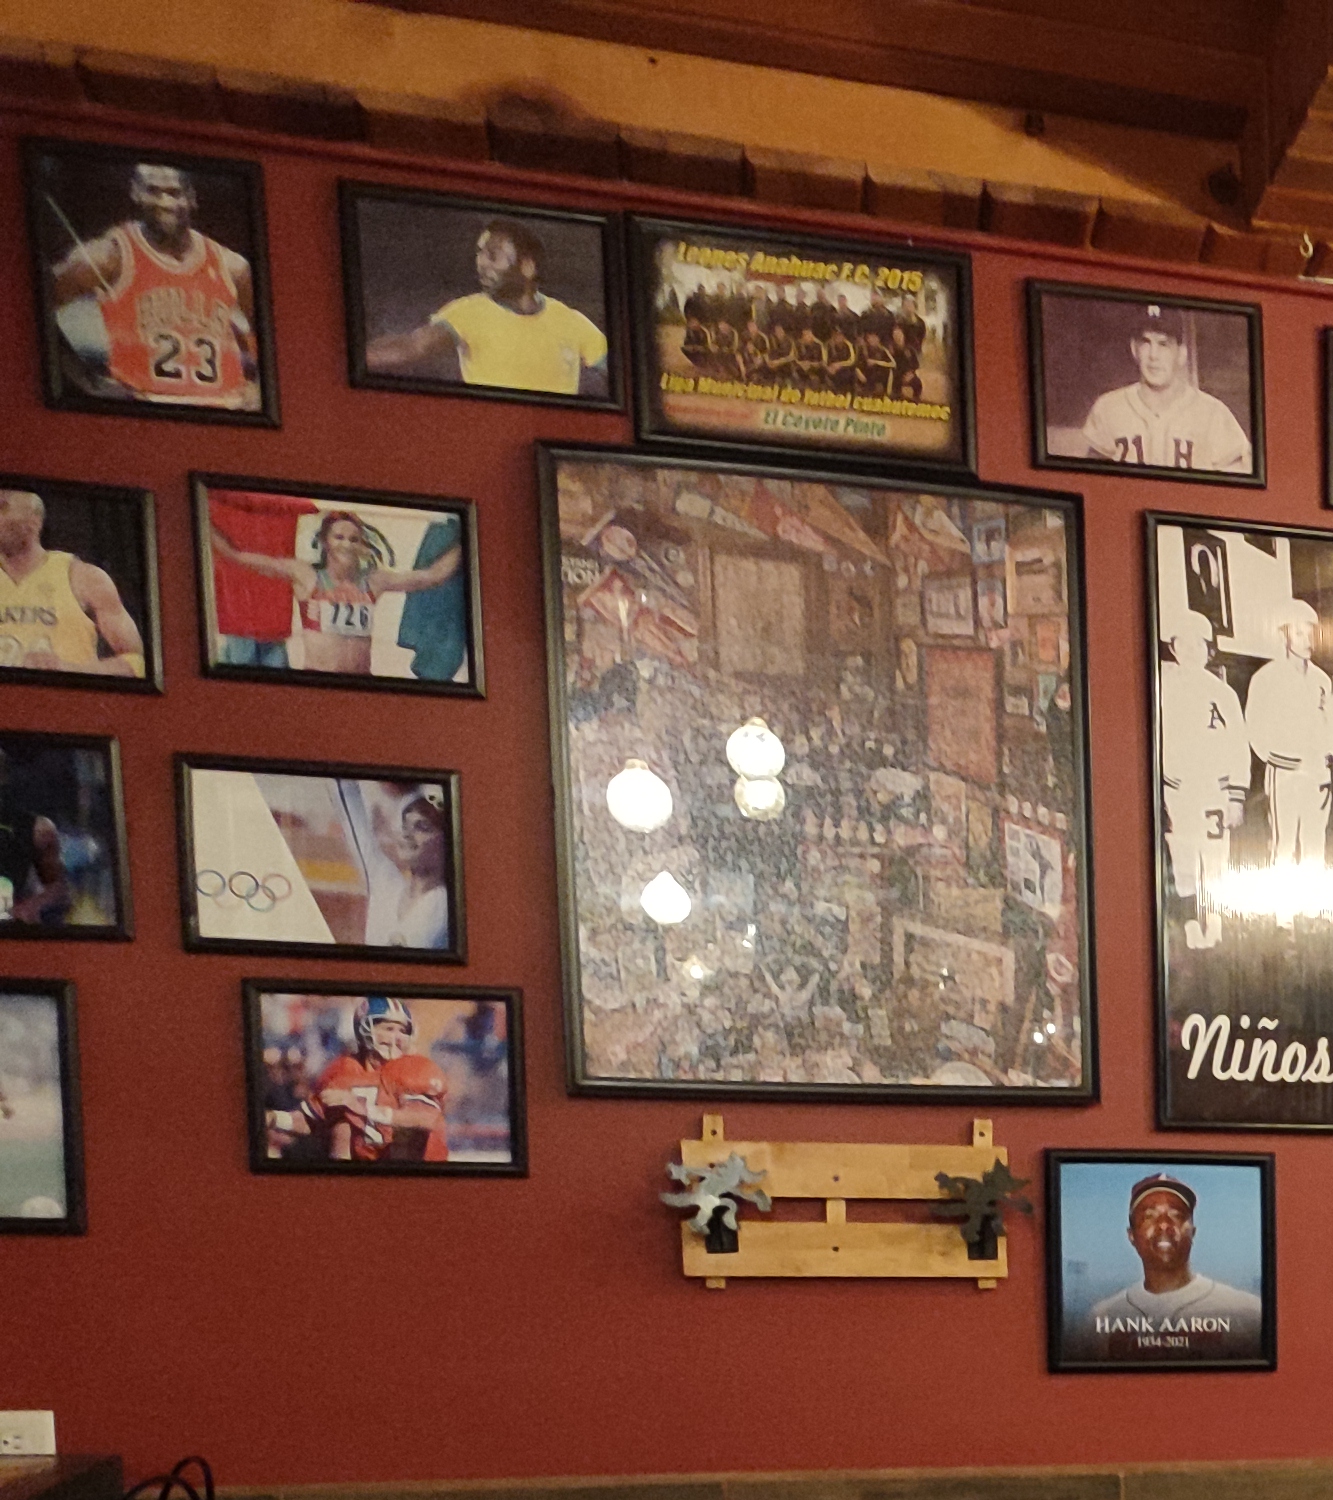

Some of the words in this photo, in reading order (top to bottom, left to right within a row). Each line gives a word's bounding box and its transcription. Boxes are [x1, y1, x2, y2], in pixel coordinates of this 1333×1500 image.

[153, 334, 218, 384] 23
[1172, 438, 1194, 469] H
[331, 602, 370, 630] 726
[1207, 702, 1227, 739] A
[1205, 810, 1225, 839] 3
[1095, 1315, 1155, 1334] HANK
[1159, 1316, 1231, 1334] AARON
